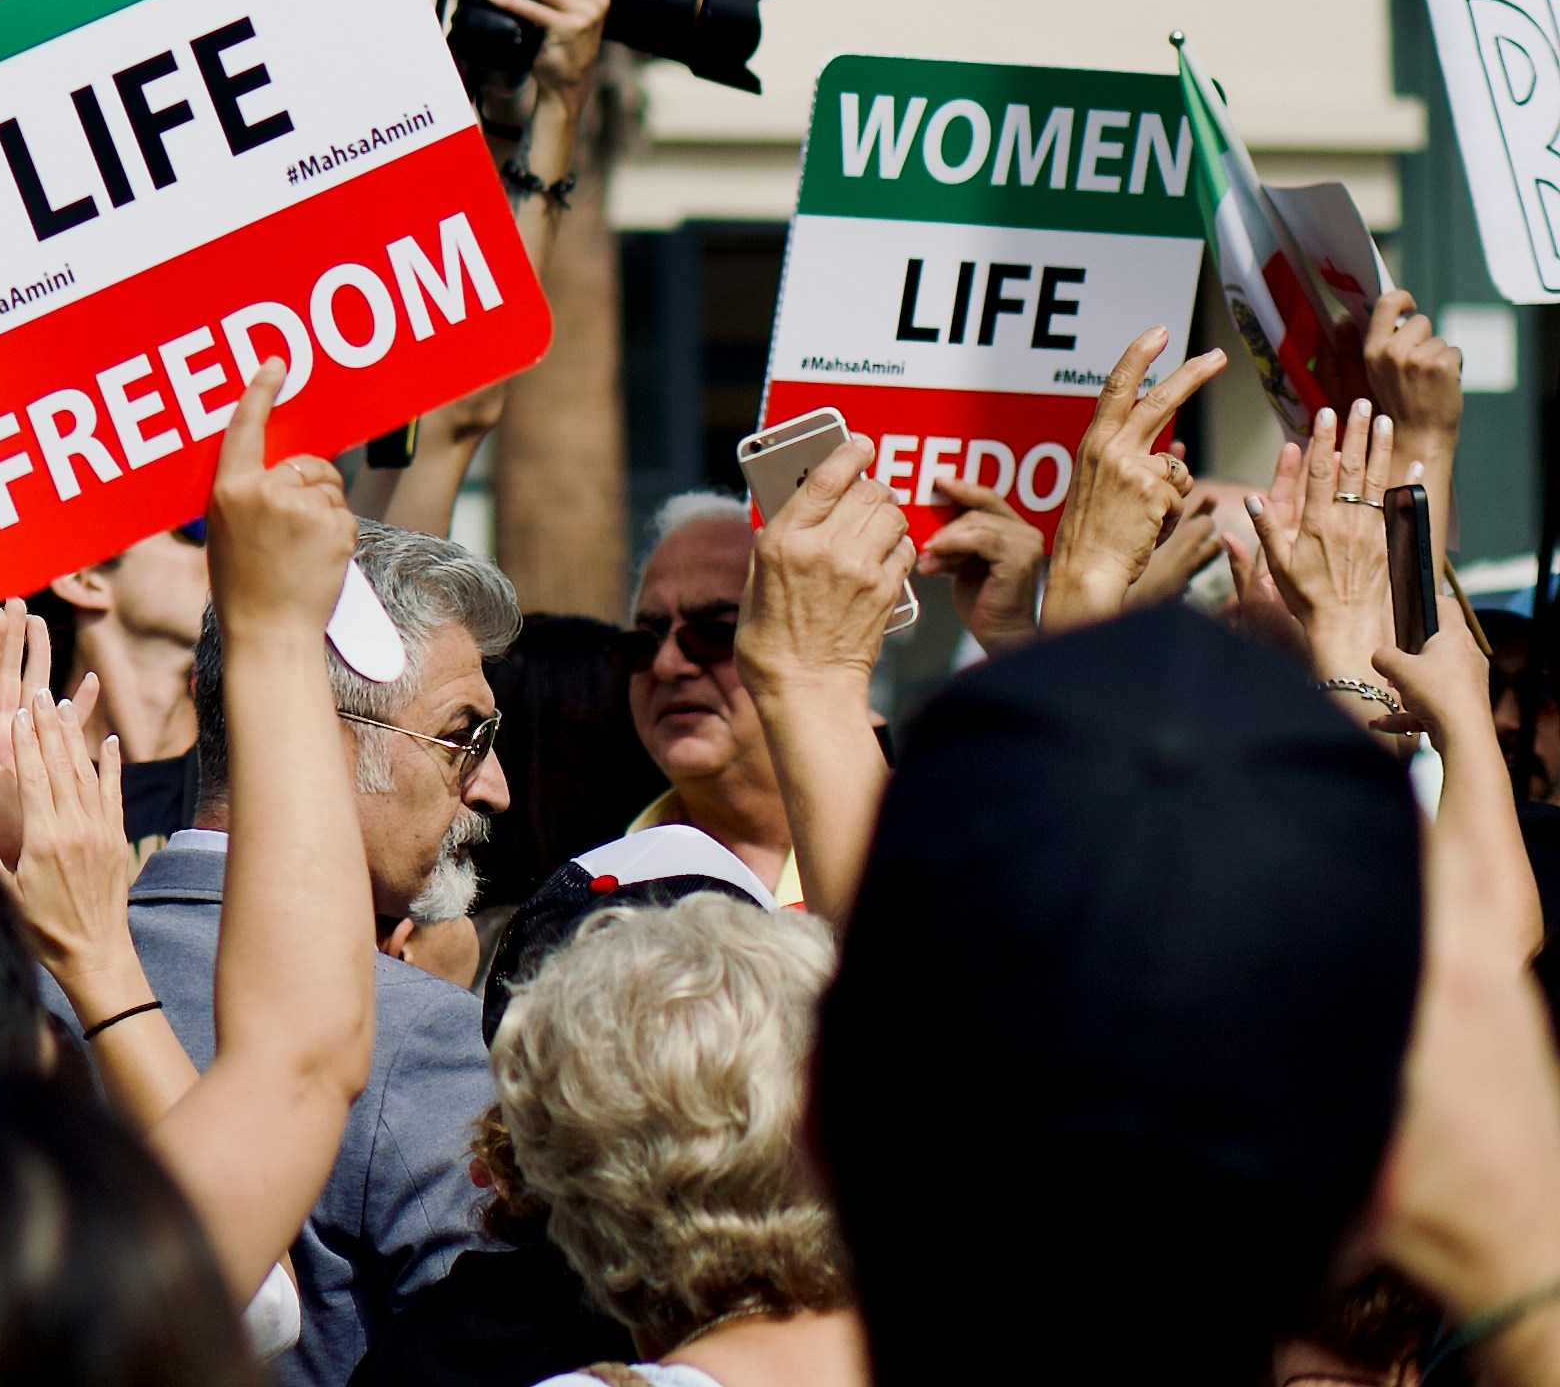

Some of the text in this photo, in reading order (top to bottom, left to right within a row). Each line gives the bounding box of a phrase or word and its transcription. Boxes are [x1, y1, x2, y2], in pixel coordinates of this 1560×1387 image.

[285, 105, 435, 187] #MahsaAmini
[839, 92, 1193, 197] WOMEN
[895, 258, 1087, 351] LIFE
[801, 355, 907, 376] #MahsaAmini
[851, 431, 1074, 513] EEDO
